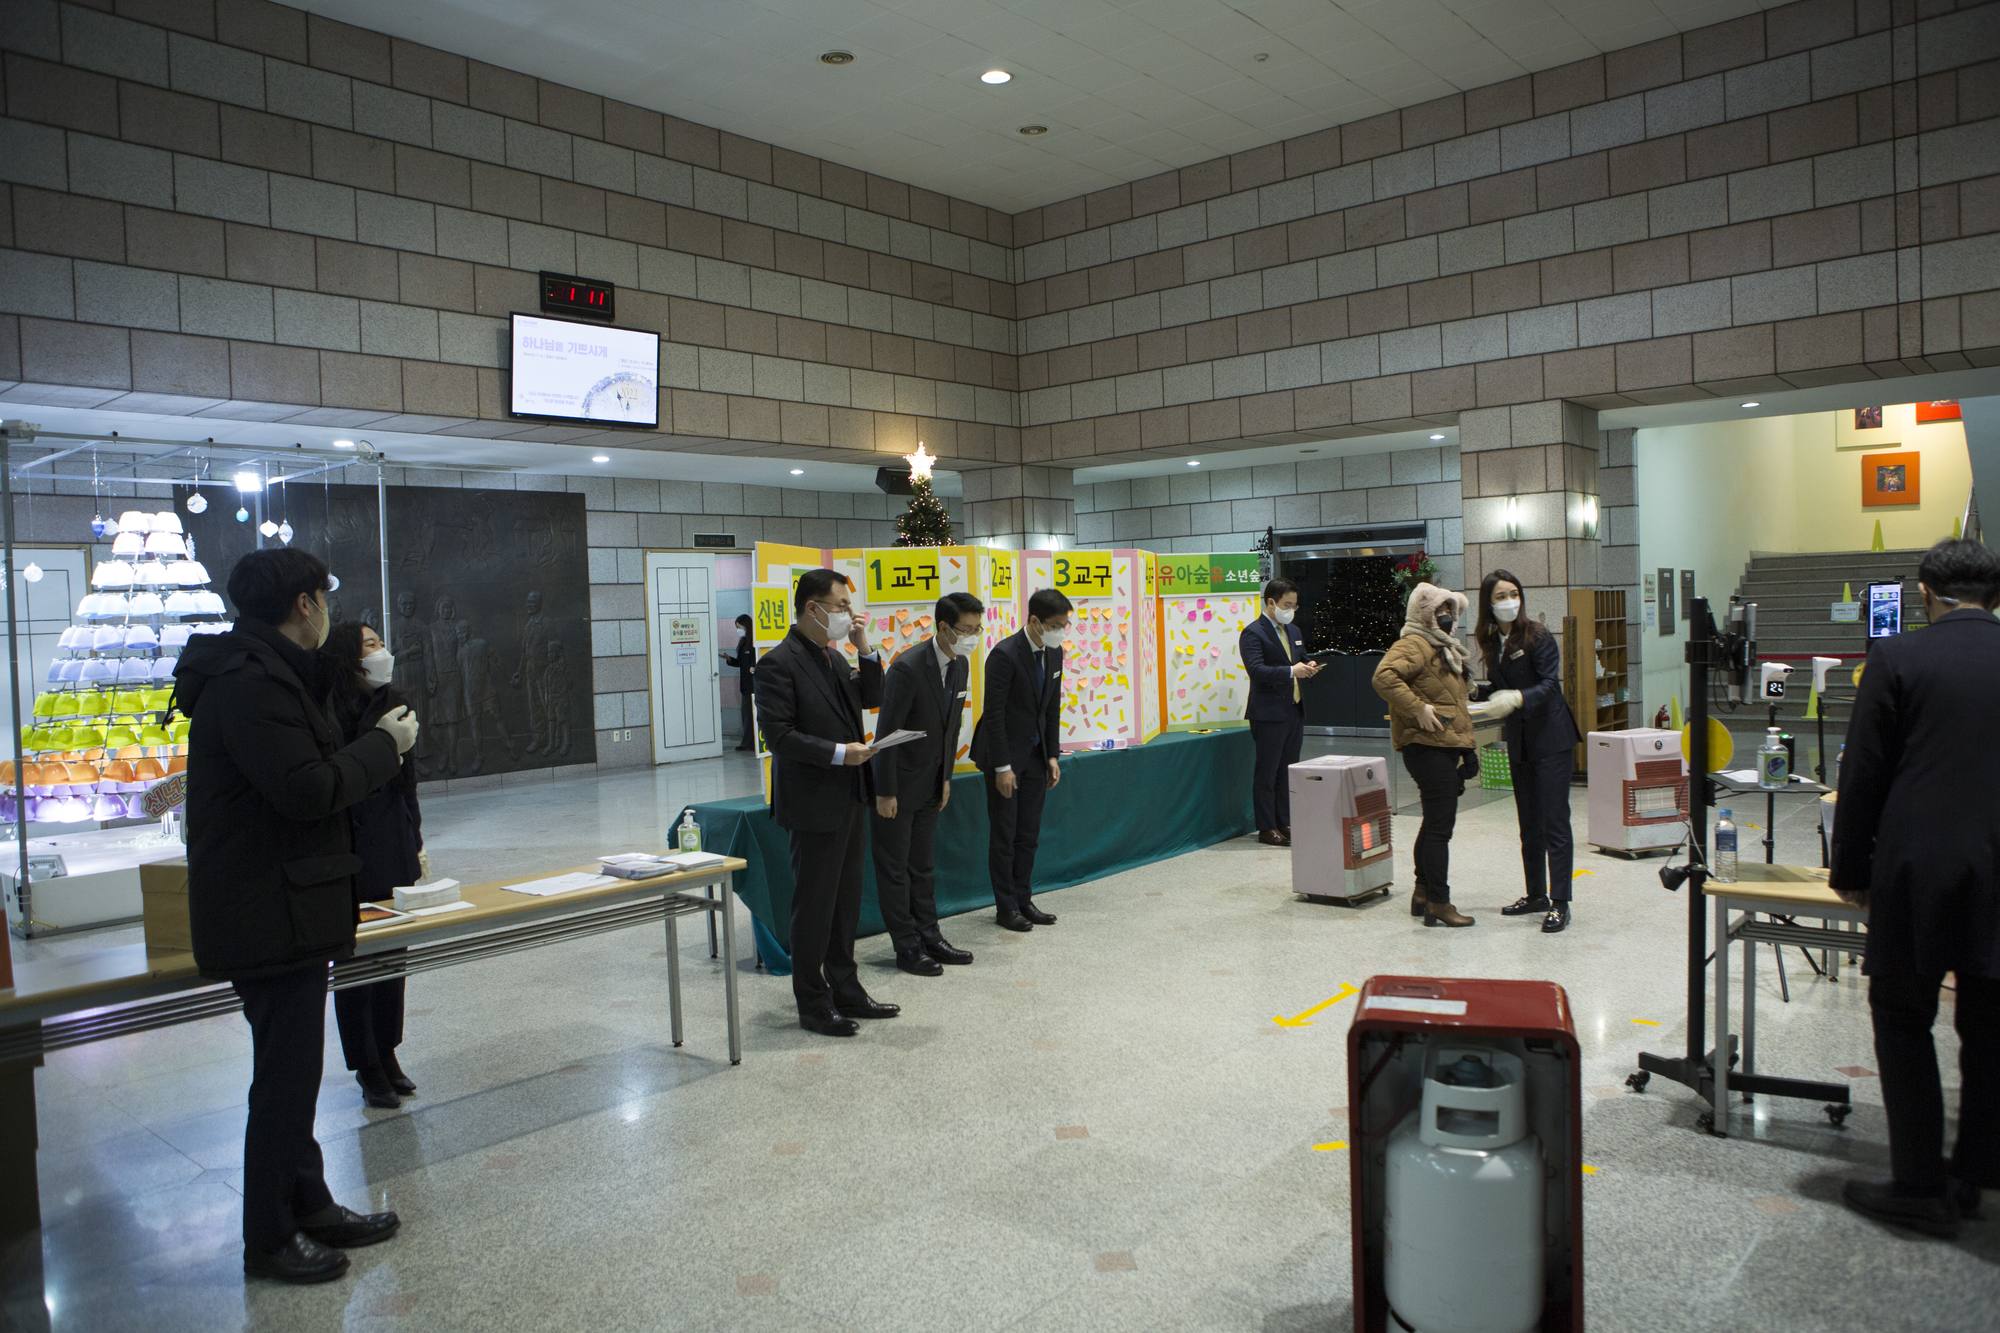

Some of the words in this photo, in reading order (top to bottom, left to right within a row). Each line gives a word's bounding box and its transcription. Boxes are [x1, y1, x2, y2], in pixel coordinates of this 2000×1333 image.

[522, 335, 564, 353] 하나님을
[567, 341, 608, 360] 기쁘시게
[991, 558, 1012, 590] 2교구
[1055, 558, 1112, 588] 3교구
[1158, 564, 1210, 586] 유아숲
[1211, 566, 1260, 584] 유소년숲
[757, 599, 786, 631] 신년
